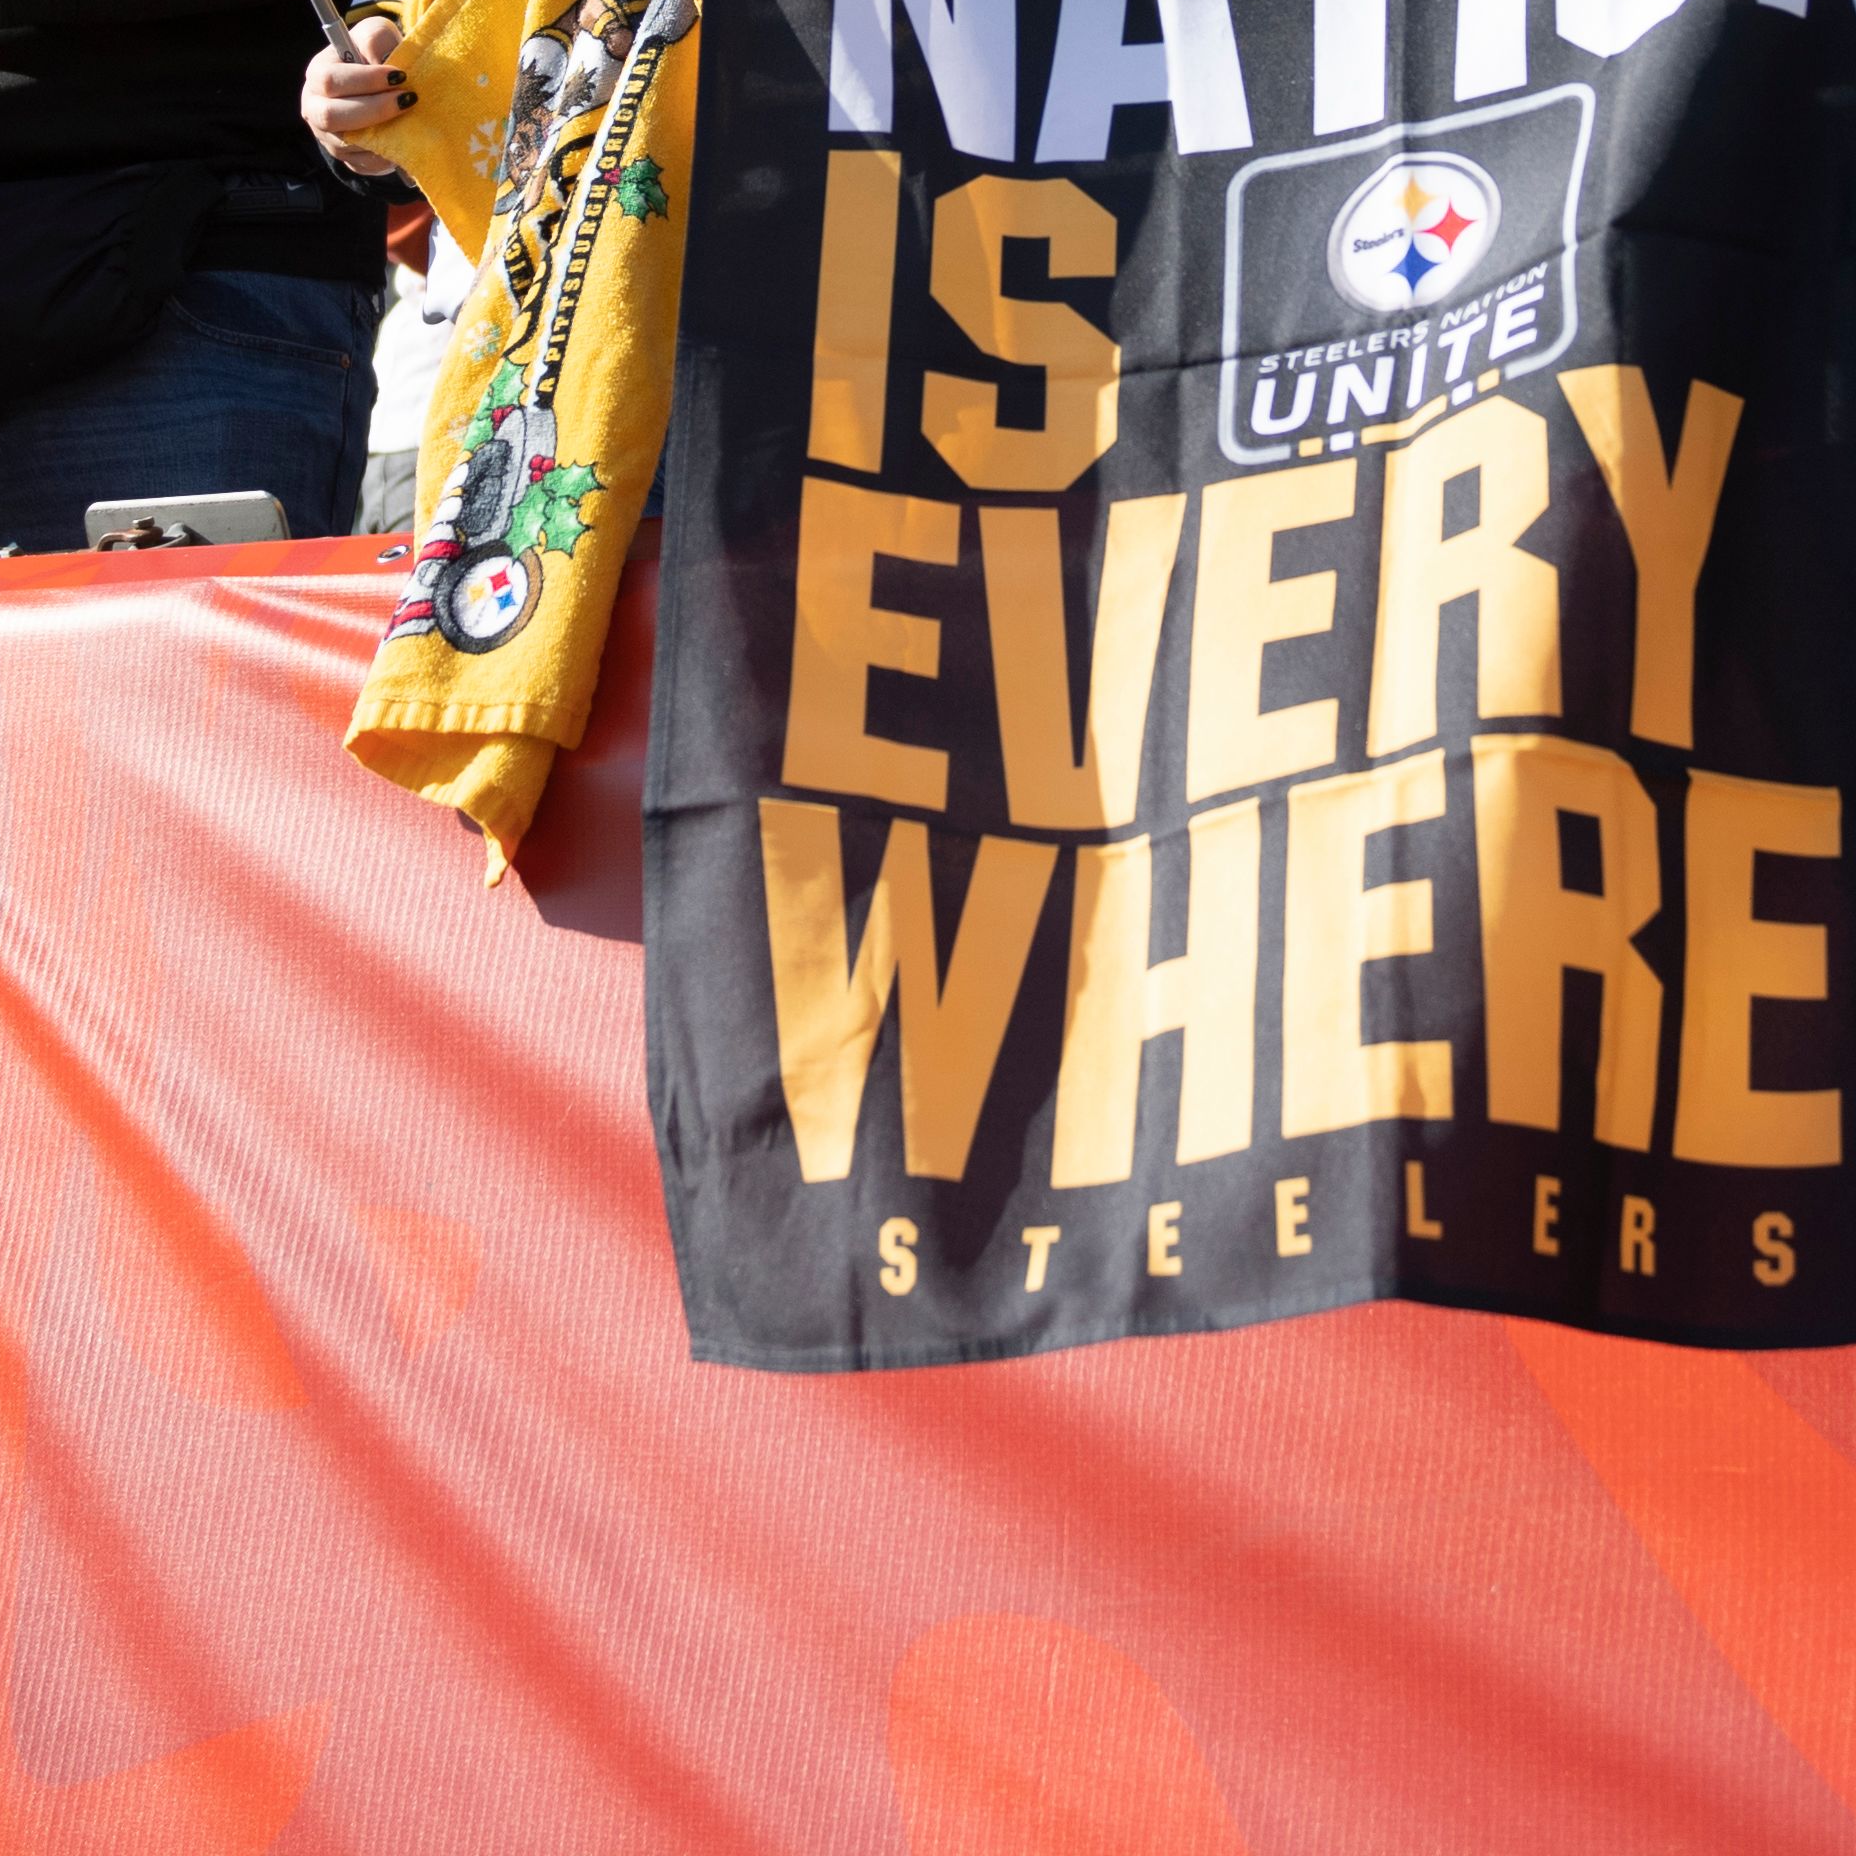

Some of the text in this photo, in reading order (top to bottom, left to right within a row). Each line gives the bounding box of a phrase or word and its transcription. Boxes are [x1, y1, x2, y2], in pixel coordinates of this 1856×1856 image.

[545, 184, 609, 362] PITTSBURGH
[598, 47, 658, 171] ORIGINAL
[806, 150, 1121, 491] IS
[1250, 285, 1544, 435] UNITE
[1258, 262, 1549, 374] STEELERS NATION
[781, 364, 1743, 830] EVERY
[759, 733, 1843, 1190] WHERE
[879, 1161, 1795, 1296] STEELERS
